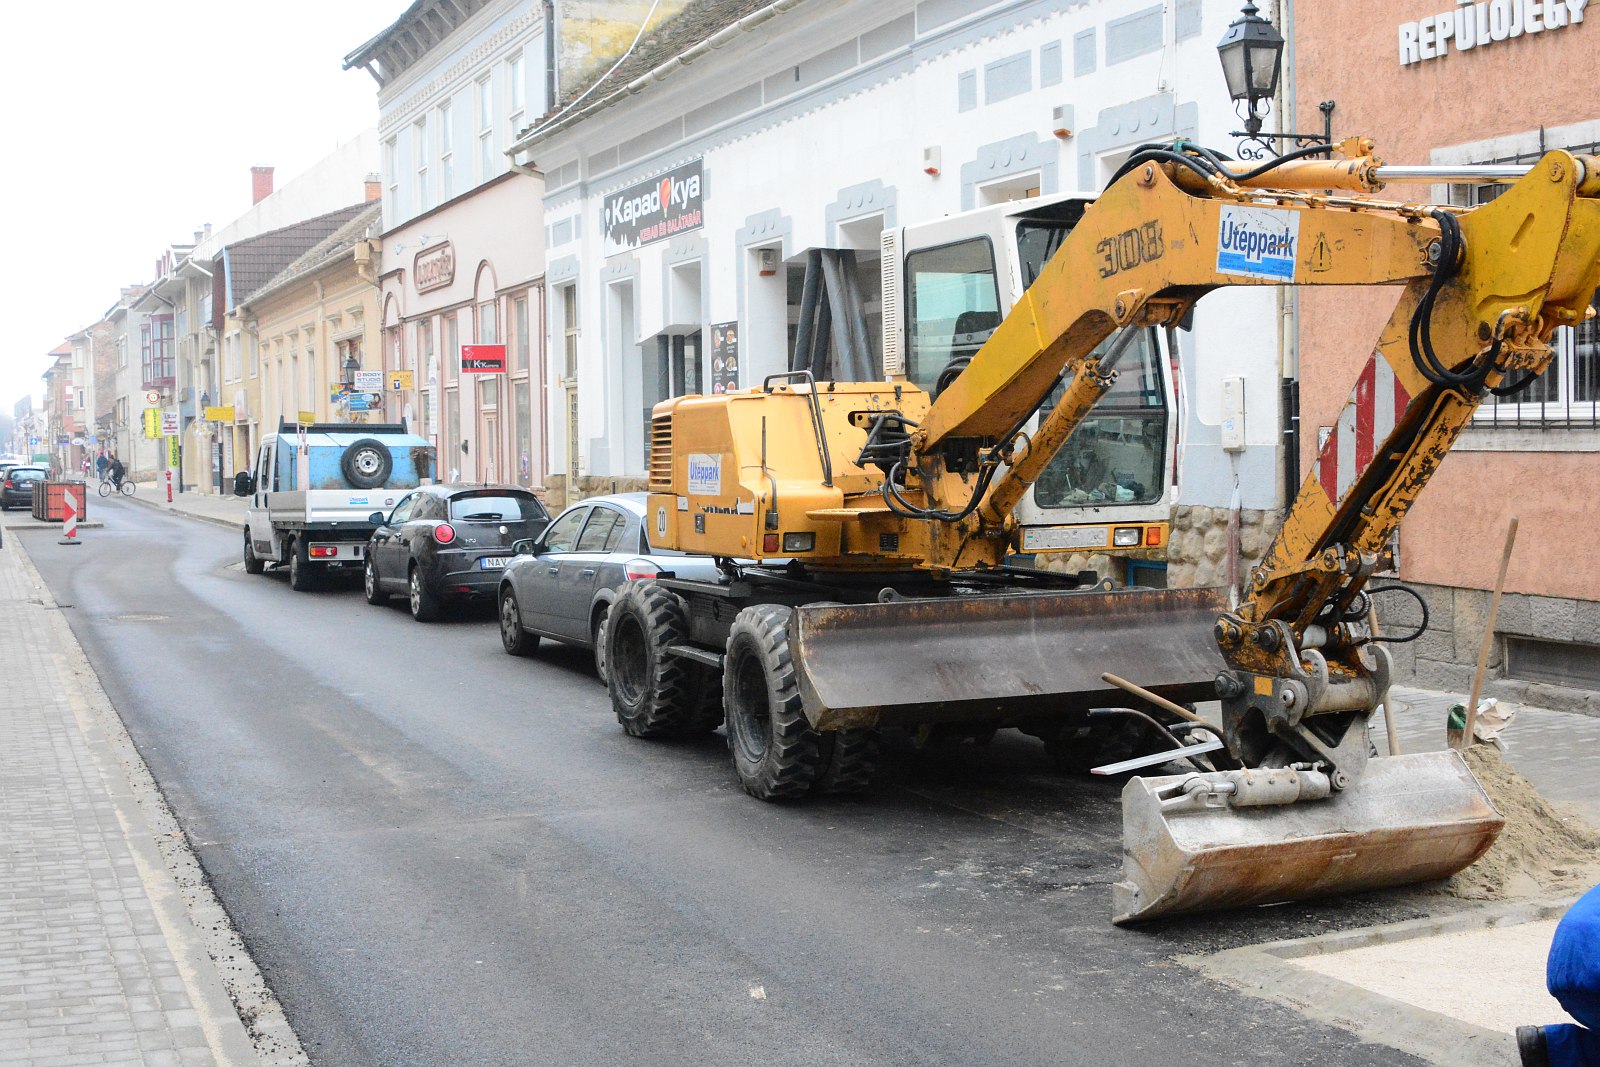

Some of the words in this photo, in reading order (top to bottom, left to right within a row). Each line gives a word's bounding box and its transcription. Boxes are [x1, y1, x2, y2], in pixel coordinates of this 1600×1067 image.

[1096, 218, 1164, 279] 308
[1220, 213, 1294, 261] Útéppark
[658, 510, 666, 532] 20
